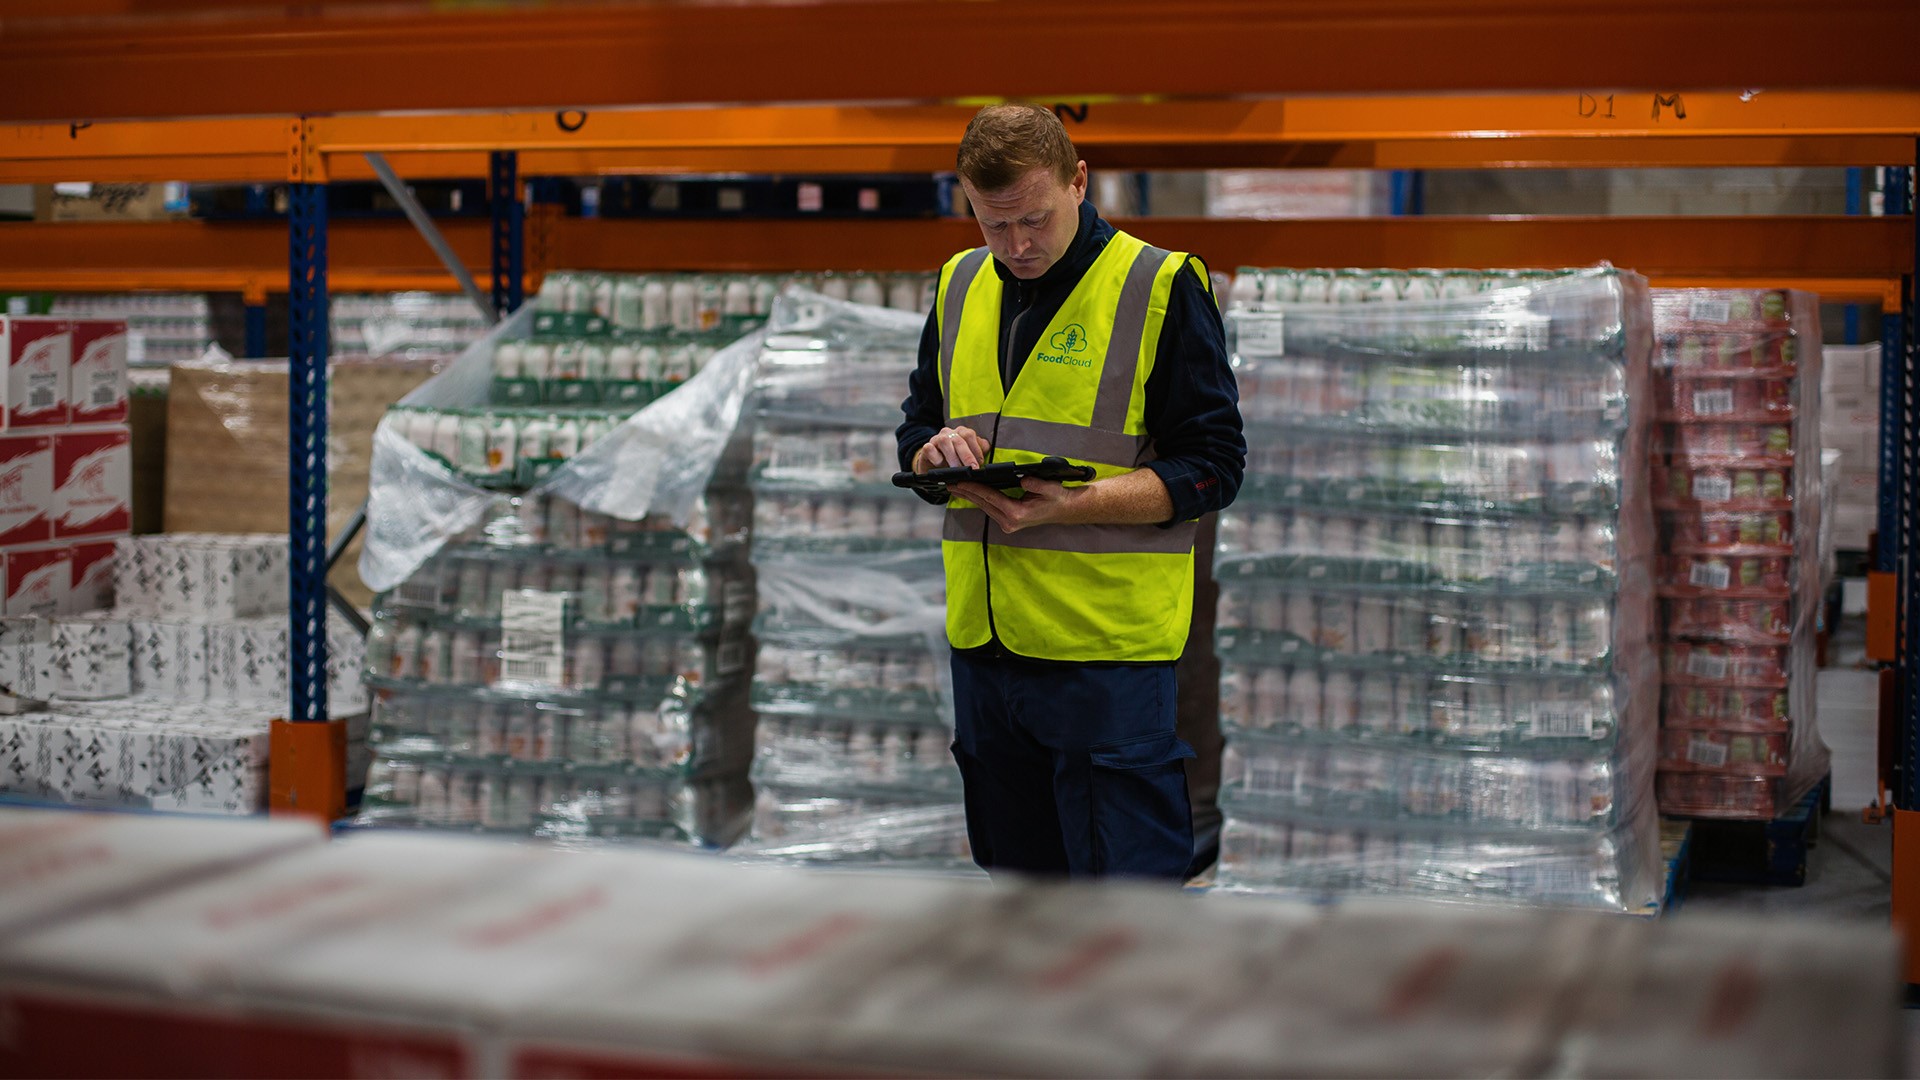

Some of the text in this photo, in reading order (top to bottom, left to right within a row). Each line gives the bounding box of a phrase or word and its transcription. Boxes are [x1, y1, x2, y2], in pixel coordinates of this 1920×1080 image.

[1578, 92, 1687, 122] D1 M
[1036, 352, 1093, 368] FoodCloud
